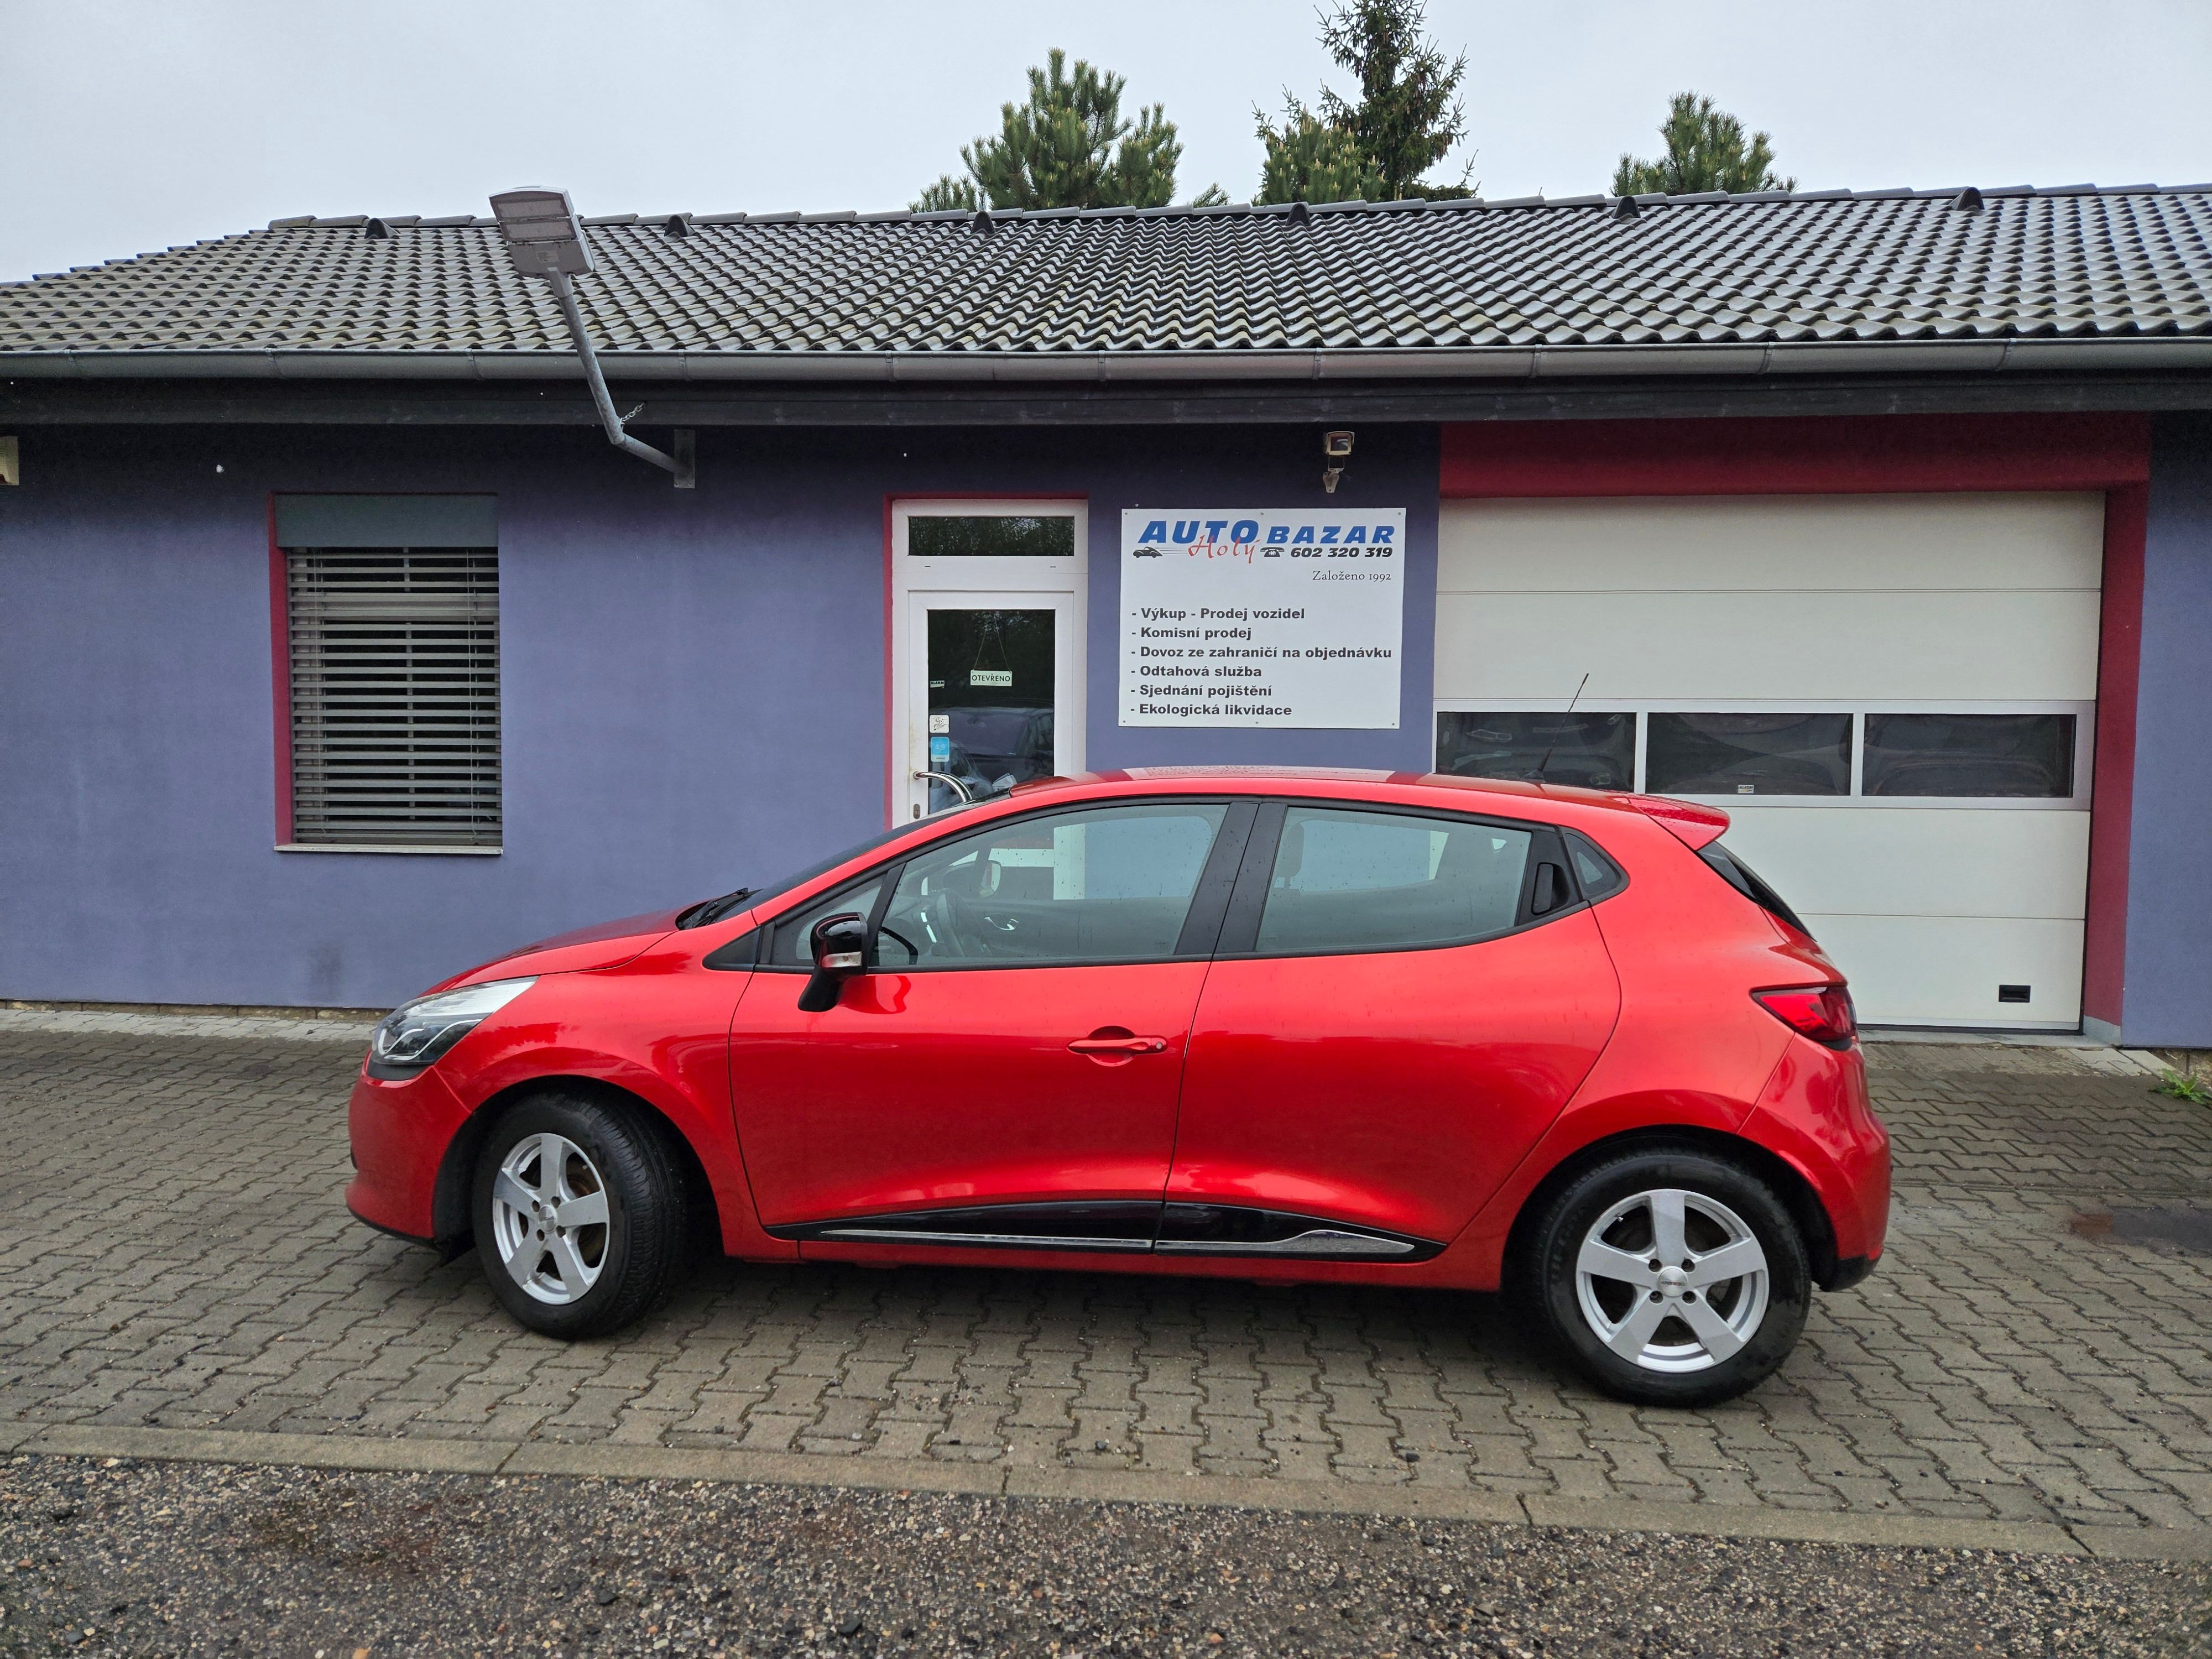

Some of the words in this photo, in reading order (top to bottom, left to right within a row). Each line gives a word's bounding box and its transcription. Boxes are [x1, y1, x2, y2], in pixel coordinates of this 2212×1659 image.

[1138, 520, 1259, 544] AUTO
[1266, 525, 1395, 544] BAZAR
[1188, 534, 1261, 564] Holý
[1291, 547, 1323, 558] 602
[1327, 547, 1360, 558] 320
[1364, 547, 1393, 558] 319
[1312, 570, 1365, 581] Založeno
[1369, 573, 1391, 583] 1992
[1141, 608, 1187, 621] Výkup
[1201, 608, 1248, 622] Prodej
[1253, 608, 1305, 619] vozidel
[1141, 627, 1200, 638] Komisní
[1204, 627, 1252, 641] prodej
[1140, 646, 1184, 657] Dovoz
[1188, 649, 1205, 657] ze
[1209, 646, 1278, 658] zahraničí
[1282, 649, 1301, 658] na
[1305, 647, 1392, 660] objednávku
[972, 673, 1010, 682] OTEVŘENO
[1140, 665, 1210, 677] Odtahová
[1214, 666, 1262, 677] služba
[1140, 684, 1203, 698] Sjednání
[1208, 685, 1272, 698] pojištění
[1140, 703, 1220, 717] Ekologická
[1225, 705, 1292, 716] likvidace
